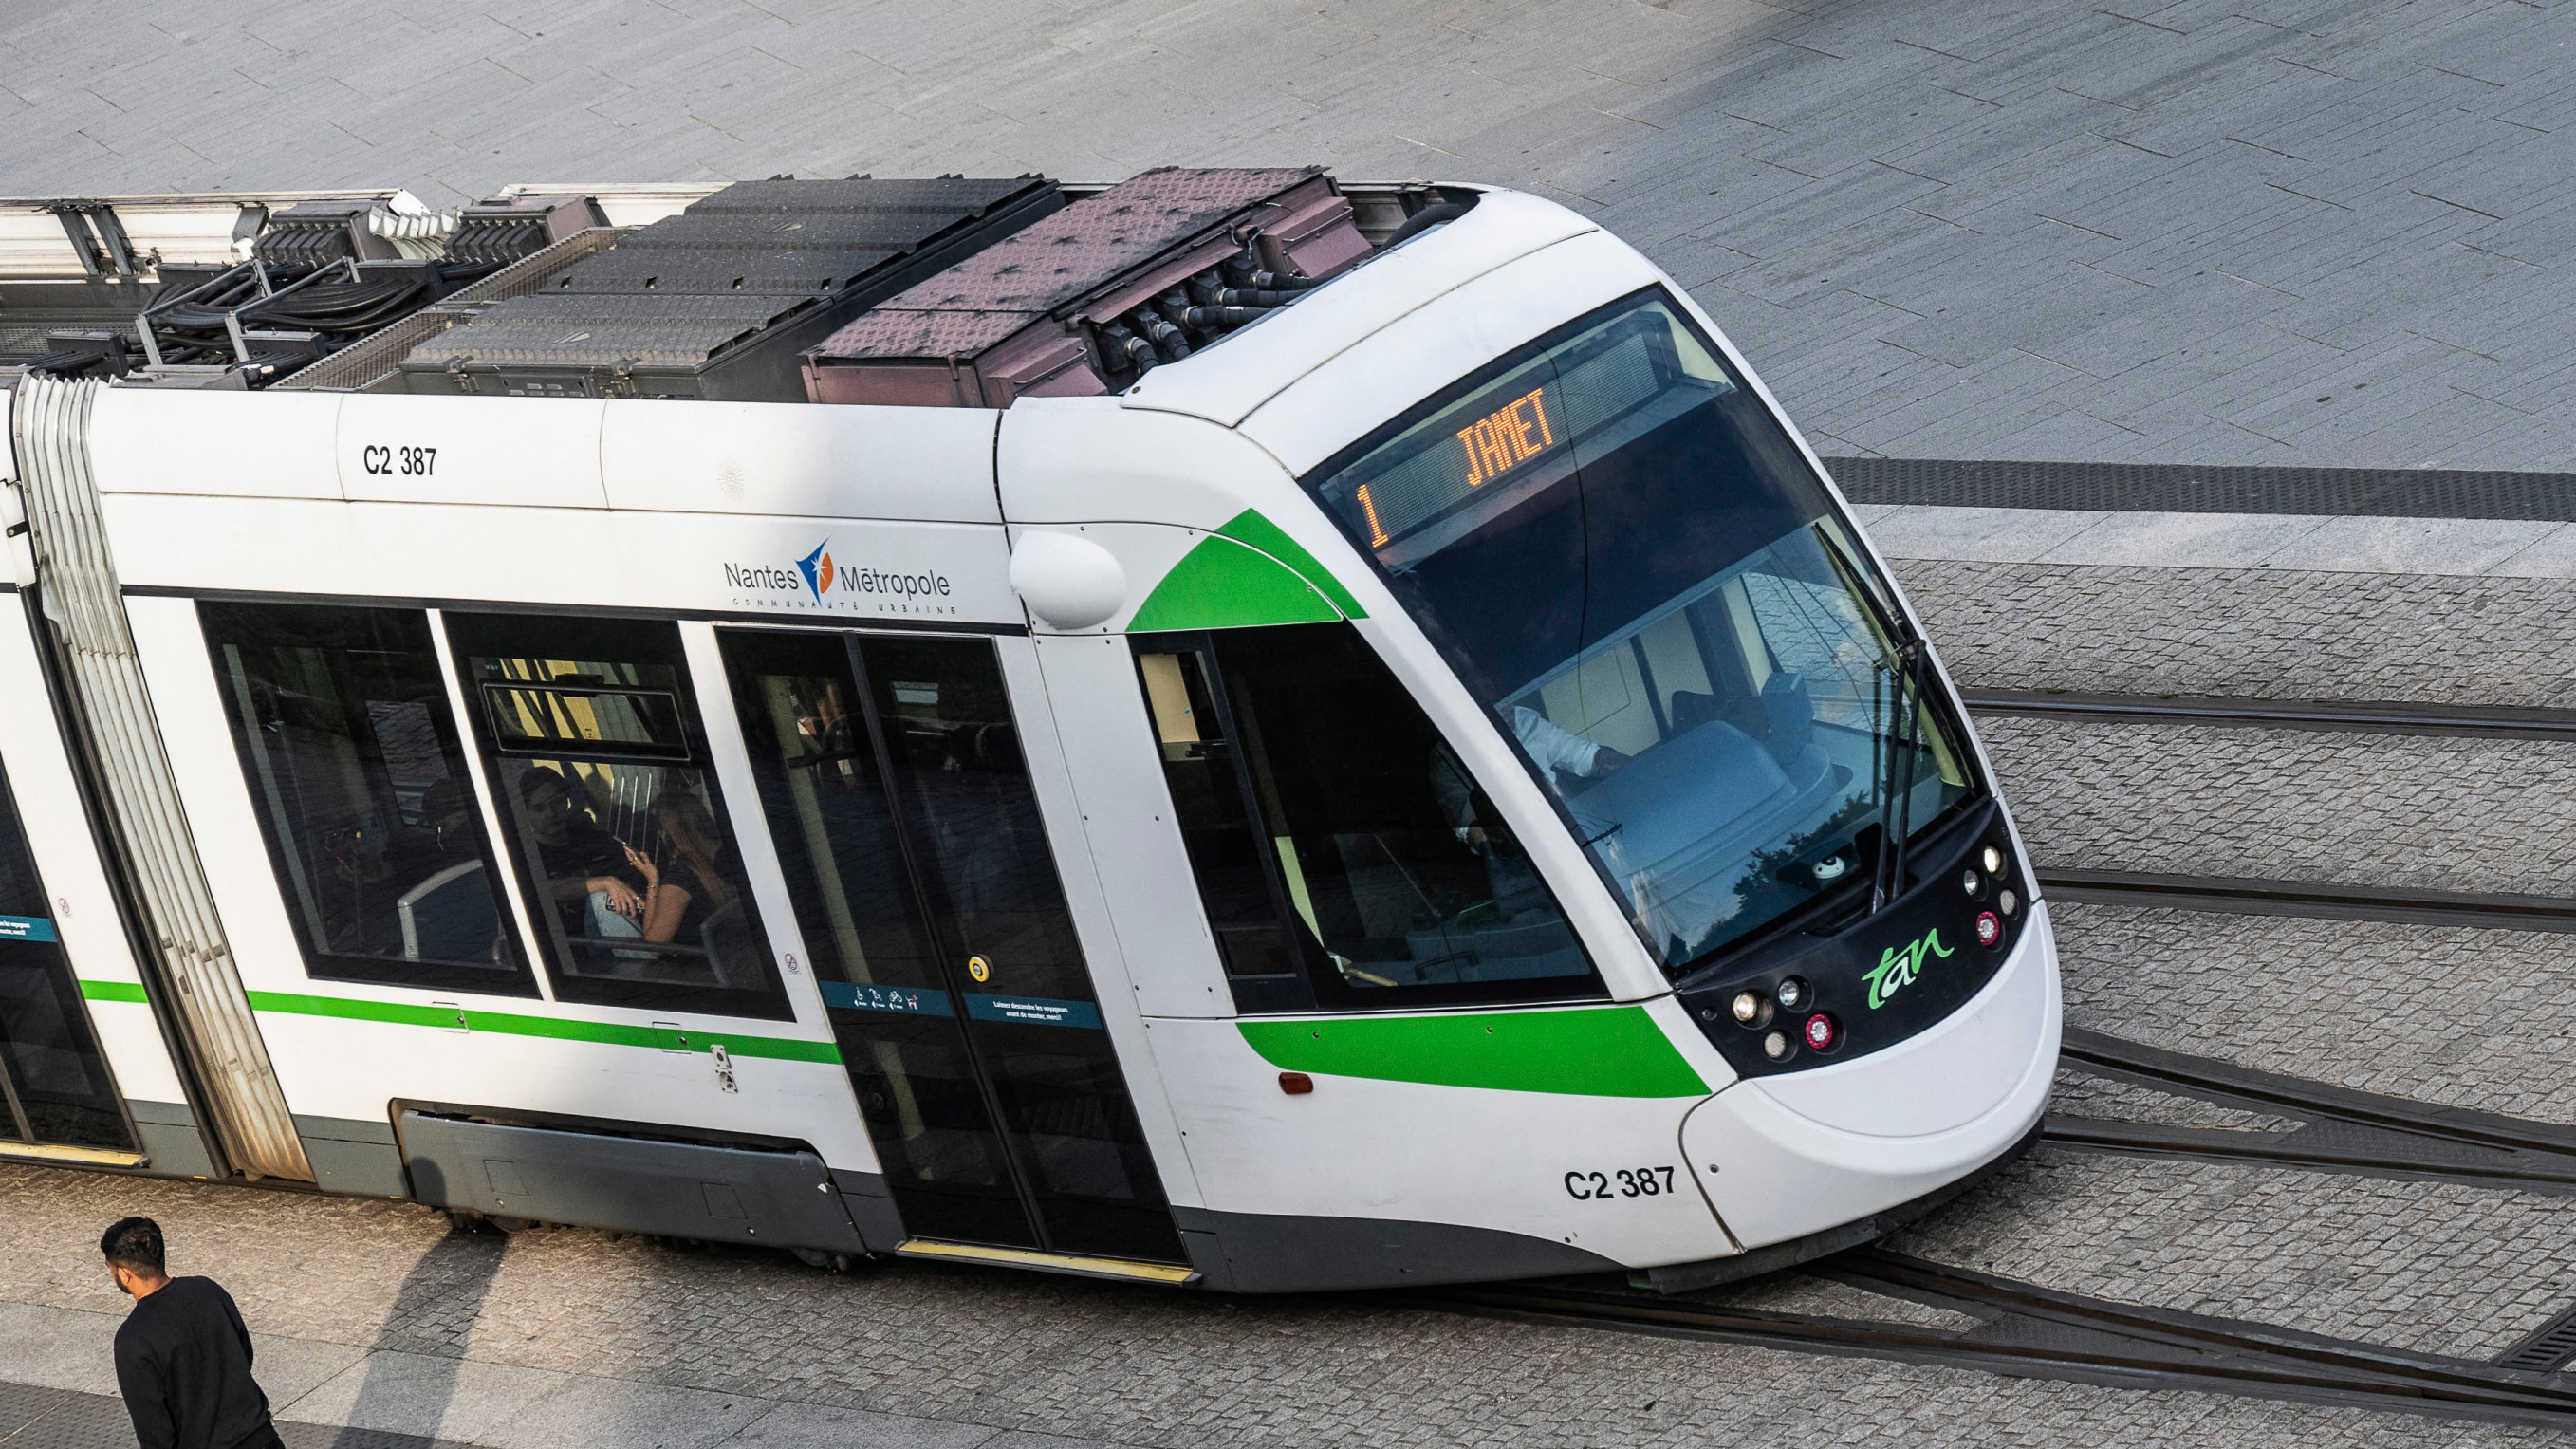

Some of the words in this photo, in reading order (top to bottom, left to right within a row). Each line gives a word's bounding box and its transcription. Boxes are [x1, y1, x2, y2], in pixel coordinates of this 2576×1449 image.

[363, 445, 393, 475] C2
[399, 446, 436, 476] 387
[1357, 484, 1388, 548] 1
[1457, 388, 1553, 486] JAMET
[724, 562, 799, 590] Nantes
[878, 604, 956, 615] URBAINE
[1862, 928, 1955, 1010] tan
[1564, 1171, 1615, 1200] C2
[1616, 1165, 1675, 1198] 387
